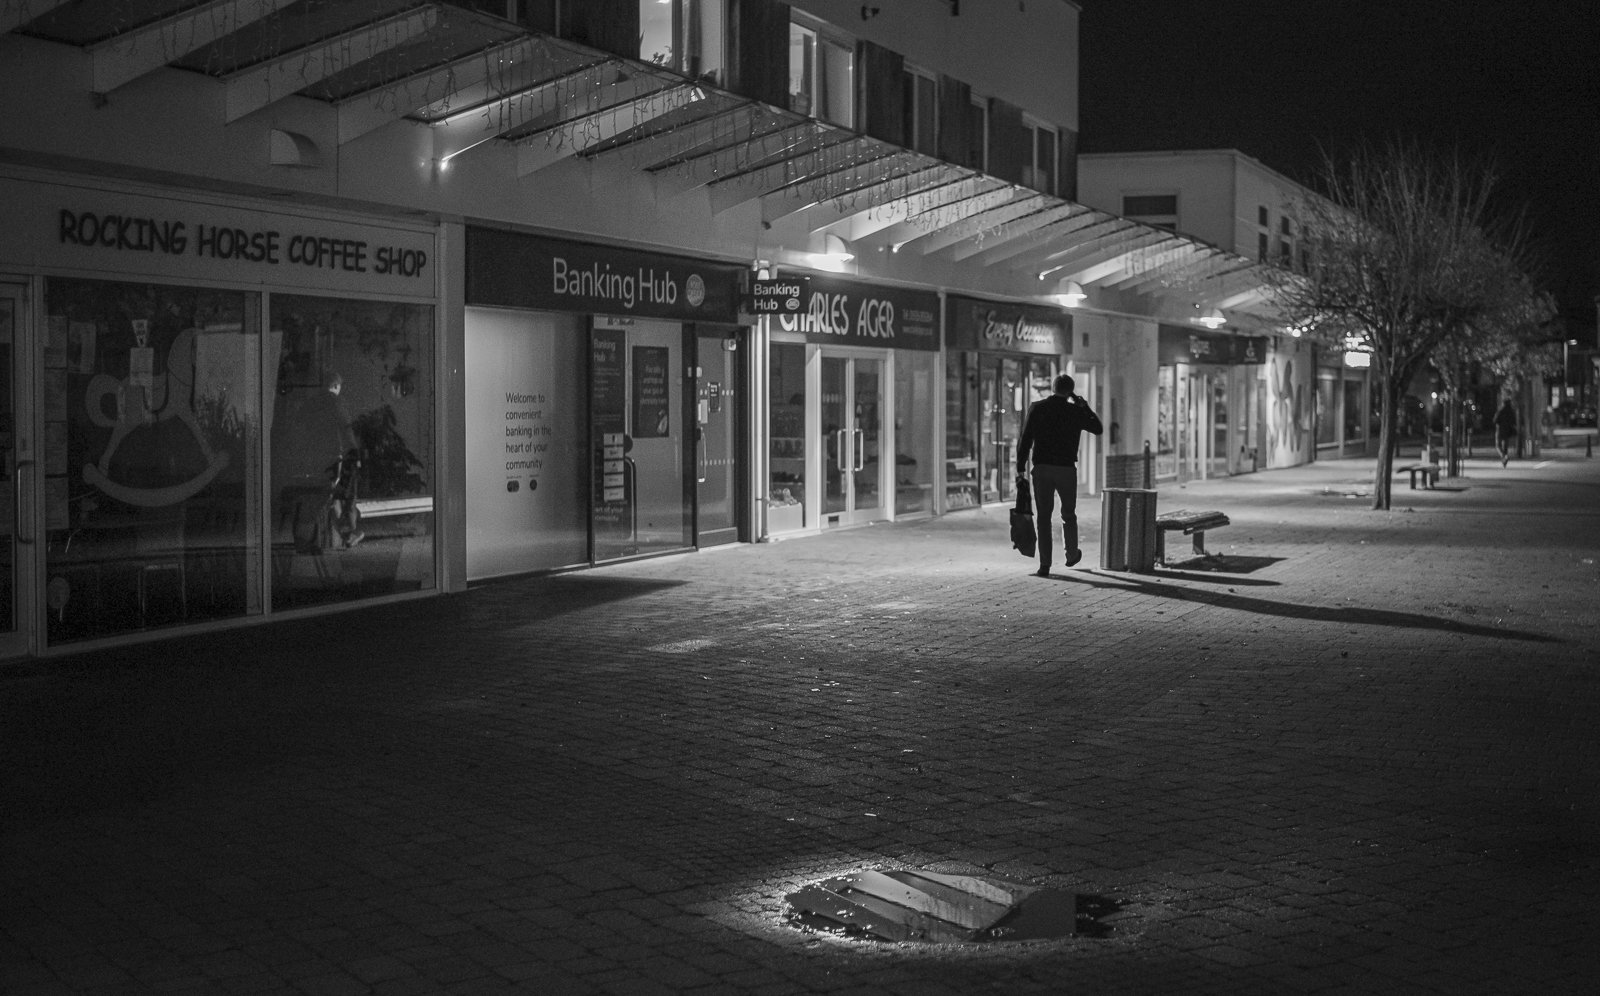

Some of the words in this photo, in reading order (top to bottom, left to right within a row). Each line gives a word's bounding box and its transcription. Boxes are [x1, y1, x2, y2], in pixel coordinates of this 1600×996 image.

[60, 209, 187, 254] ROCKING
[198, 224, 280, 265] HORSE
[288, 234, 367, 272] COFFEE
[376, 247, 427, 279] SHOP
[552, 257, 634, 309] Banking
[638, 268, 678, 305] Hub
[753, 283, 800, 298] Banking
[753, 298, 779, 311] Hub
[857, 298, 896, 339] AGER
[505, 391, 537, 404] Welcome
[538, 393, 546, 404] to
[505, 410, 542, 420] convenient
[505, 424, 533, 438] banking
[533, 423, 540, 436] in
[541, 423, 552, 437] the
[505, 441, 524, 454] heart
[525, 441, 532, 453] of
[533, 443, 548, 454] your
[505, 458, 543, 471] community
